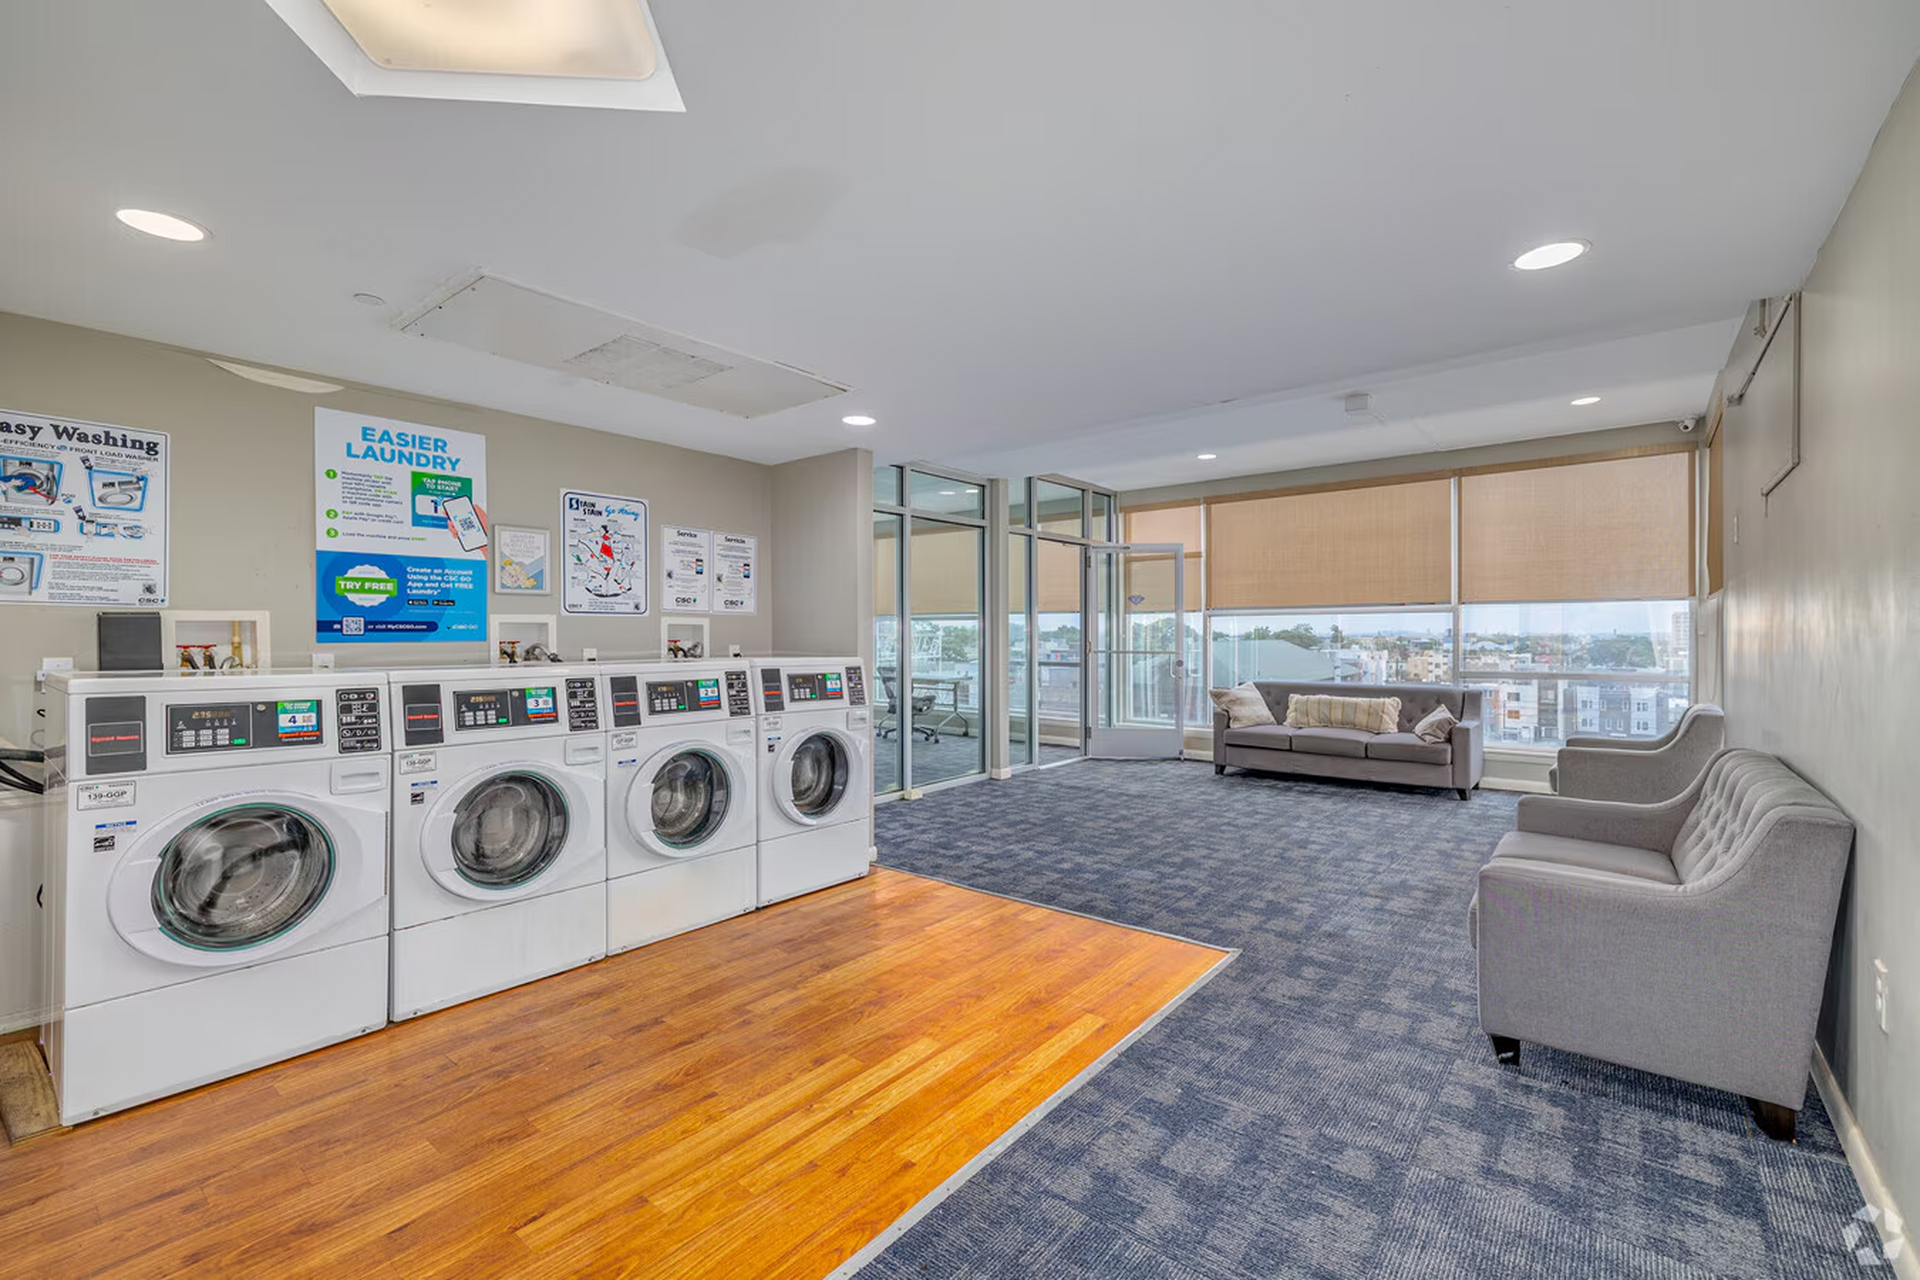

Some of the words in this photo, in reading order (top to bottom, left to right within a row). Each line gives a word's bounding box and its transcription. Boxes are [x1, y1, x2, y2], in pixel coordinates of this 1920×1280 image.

[50, 423, 160, 456] Washing
[361, 426, 448, 453] EASIER
[69, 446, 98, 455] FRONT
[100, 450, 123, 459] LOAD
[125, 453, 159, 463] WASHER
[346, 442, 461, 472] LAUNDRY
[583, 508, 603, 517] STAIN
[617, 507, 641, 521] Away
[604, 505, 616, 518] Go
[677, 530, 698, 539] Service
[338, 580, 361, 590] TRY
[364, 582, 394, 591] FREE
[704, 688, 709, 696] 2
[533, 699, 540, 707] 3
[288, 715, 297, 724] 4
[87, 790, 128, 800] 139-GGP
